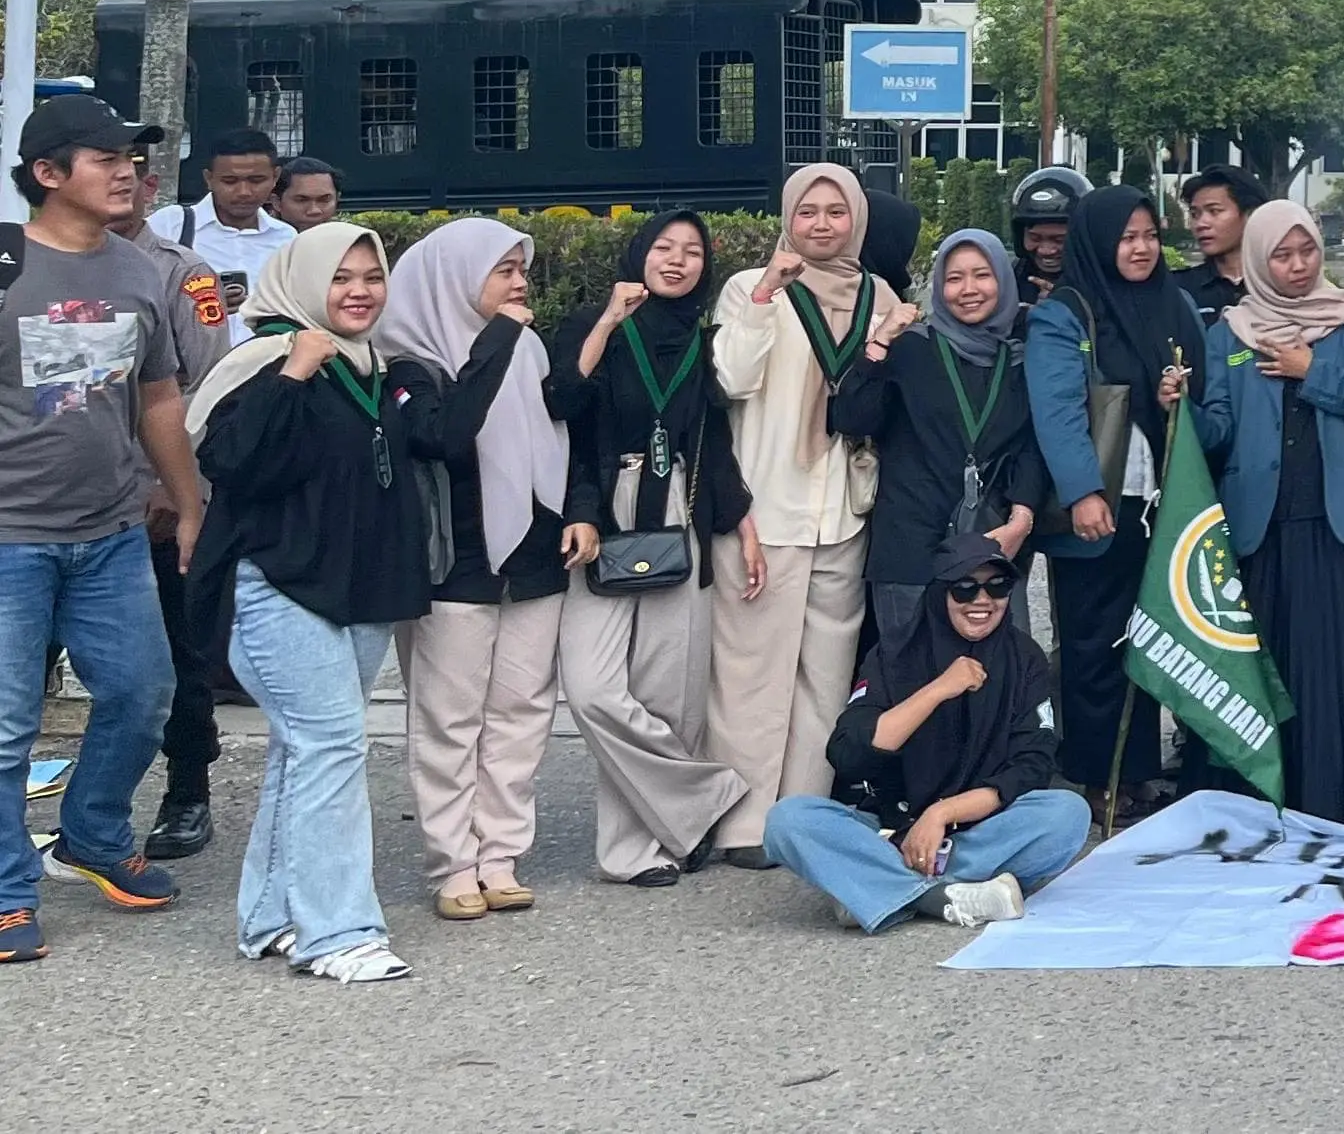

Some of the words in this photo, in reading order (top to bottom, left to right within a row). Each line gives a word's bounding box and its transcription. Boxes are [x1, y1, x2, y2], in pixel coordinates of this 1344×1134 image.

[881, 75, 937, 89] MASUK
[1145, 631, 1231, 711] BATANG
[1217, 693, 1275, 752] HARI
